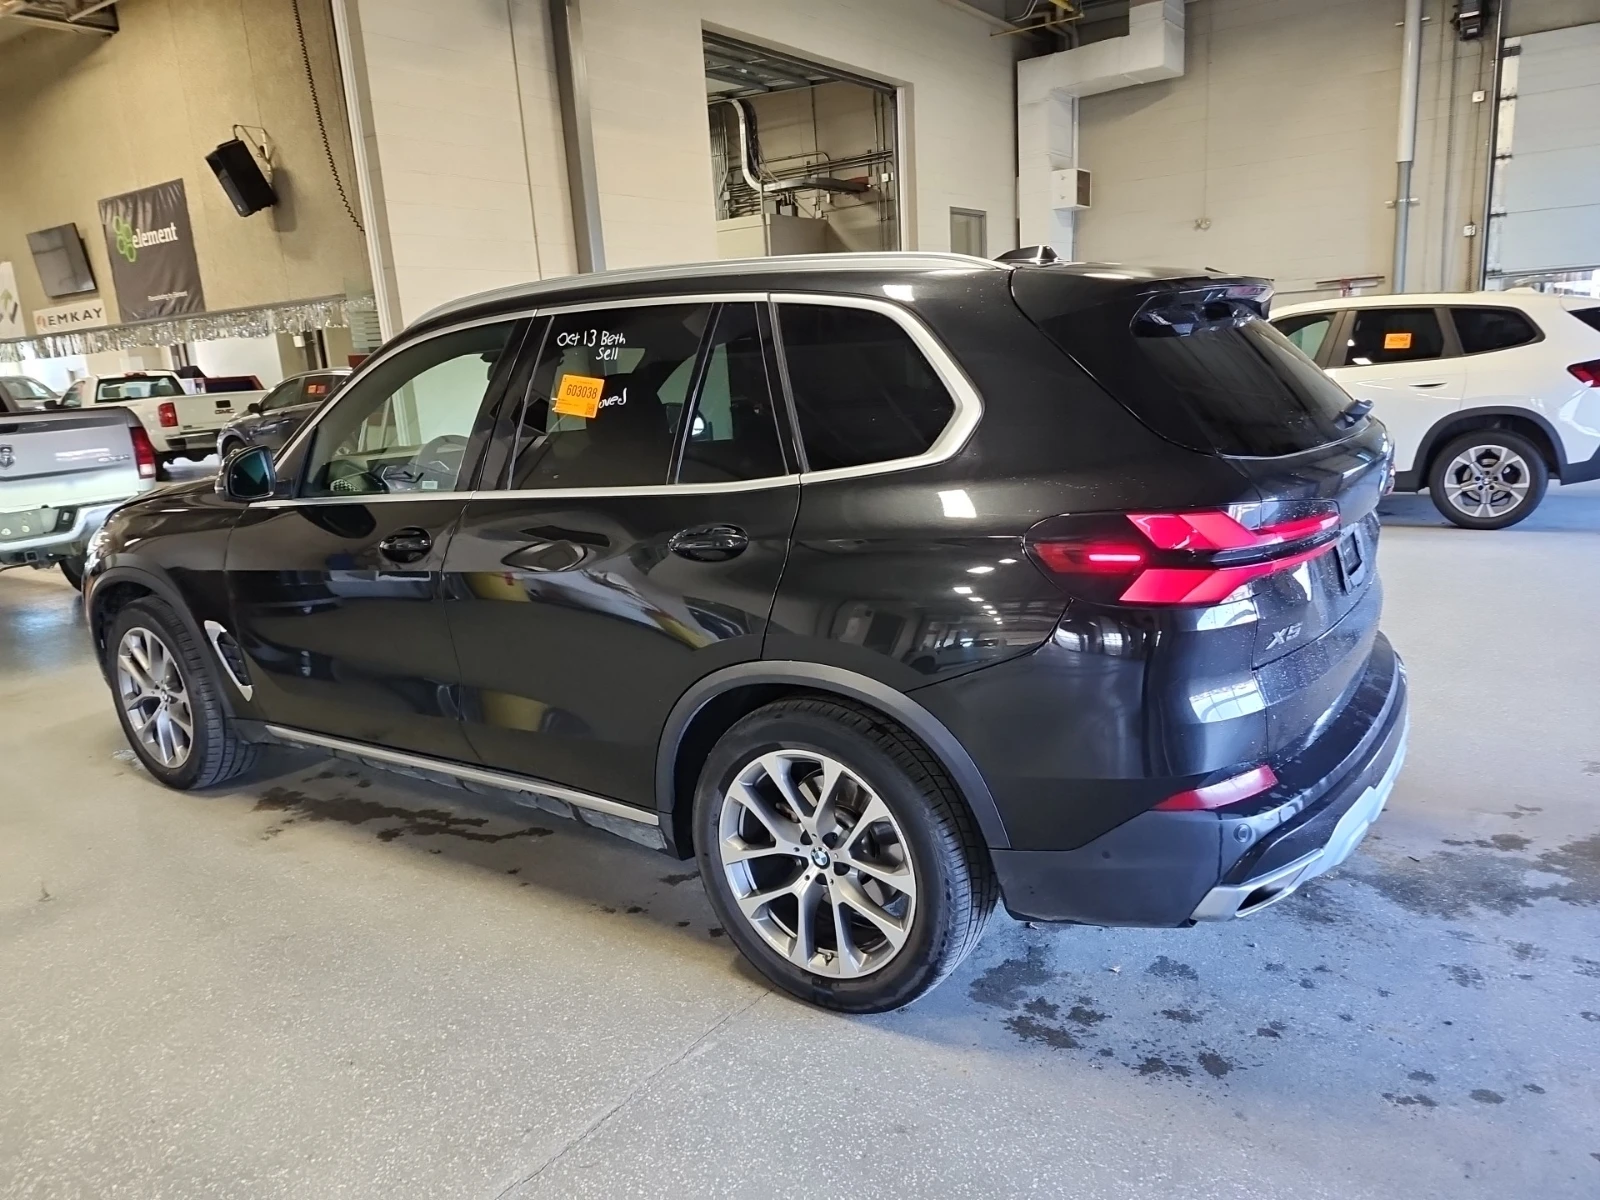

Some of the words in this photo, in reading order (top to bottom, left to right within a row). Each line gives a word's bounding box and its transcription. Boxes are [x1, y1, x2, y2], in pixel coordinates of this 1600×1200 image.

[132, 222, 178, 248] element
[47, 308, 102, 326] EMKAY
[557, 332, 580, 346] Oct
[583, 329, 597, 347] 13
[600, 330, 626, 346] Beth
[595, 347, 619, 360] Sell
[566, 384, 598, 400] 603038
[598, 387, 628, 409] oved
[1265, 622, 1303, 651] X5
